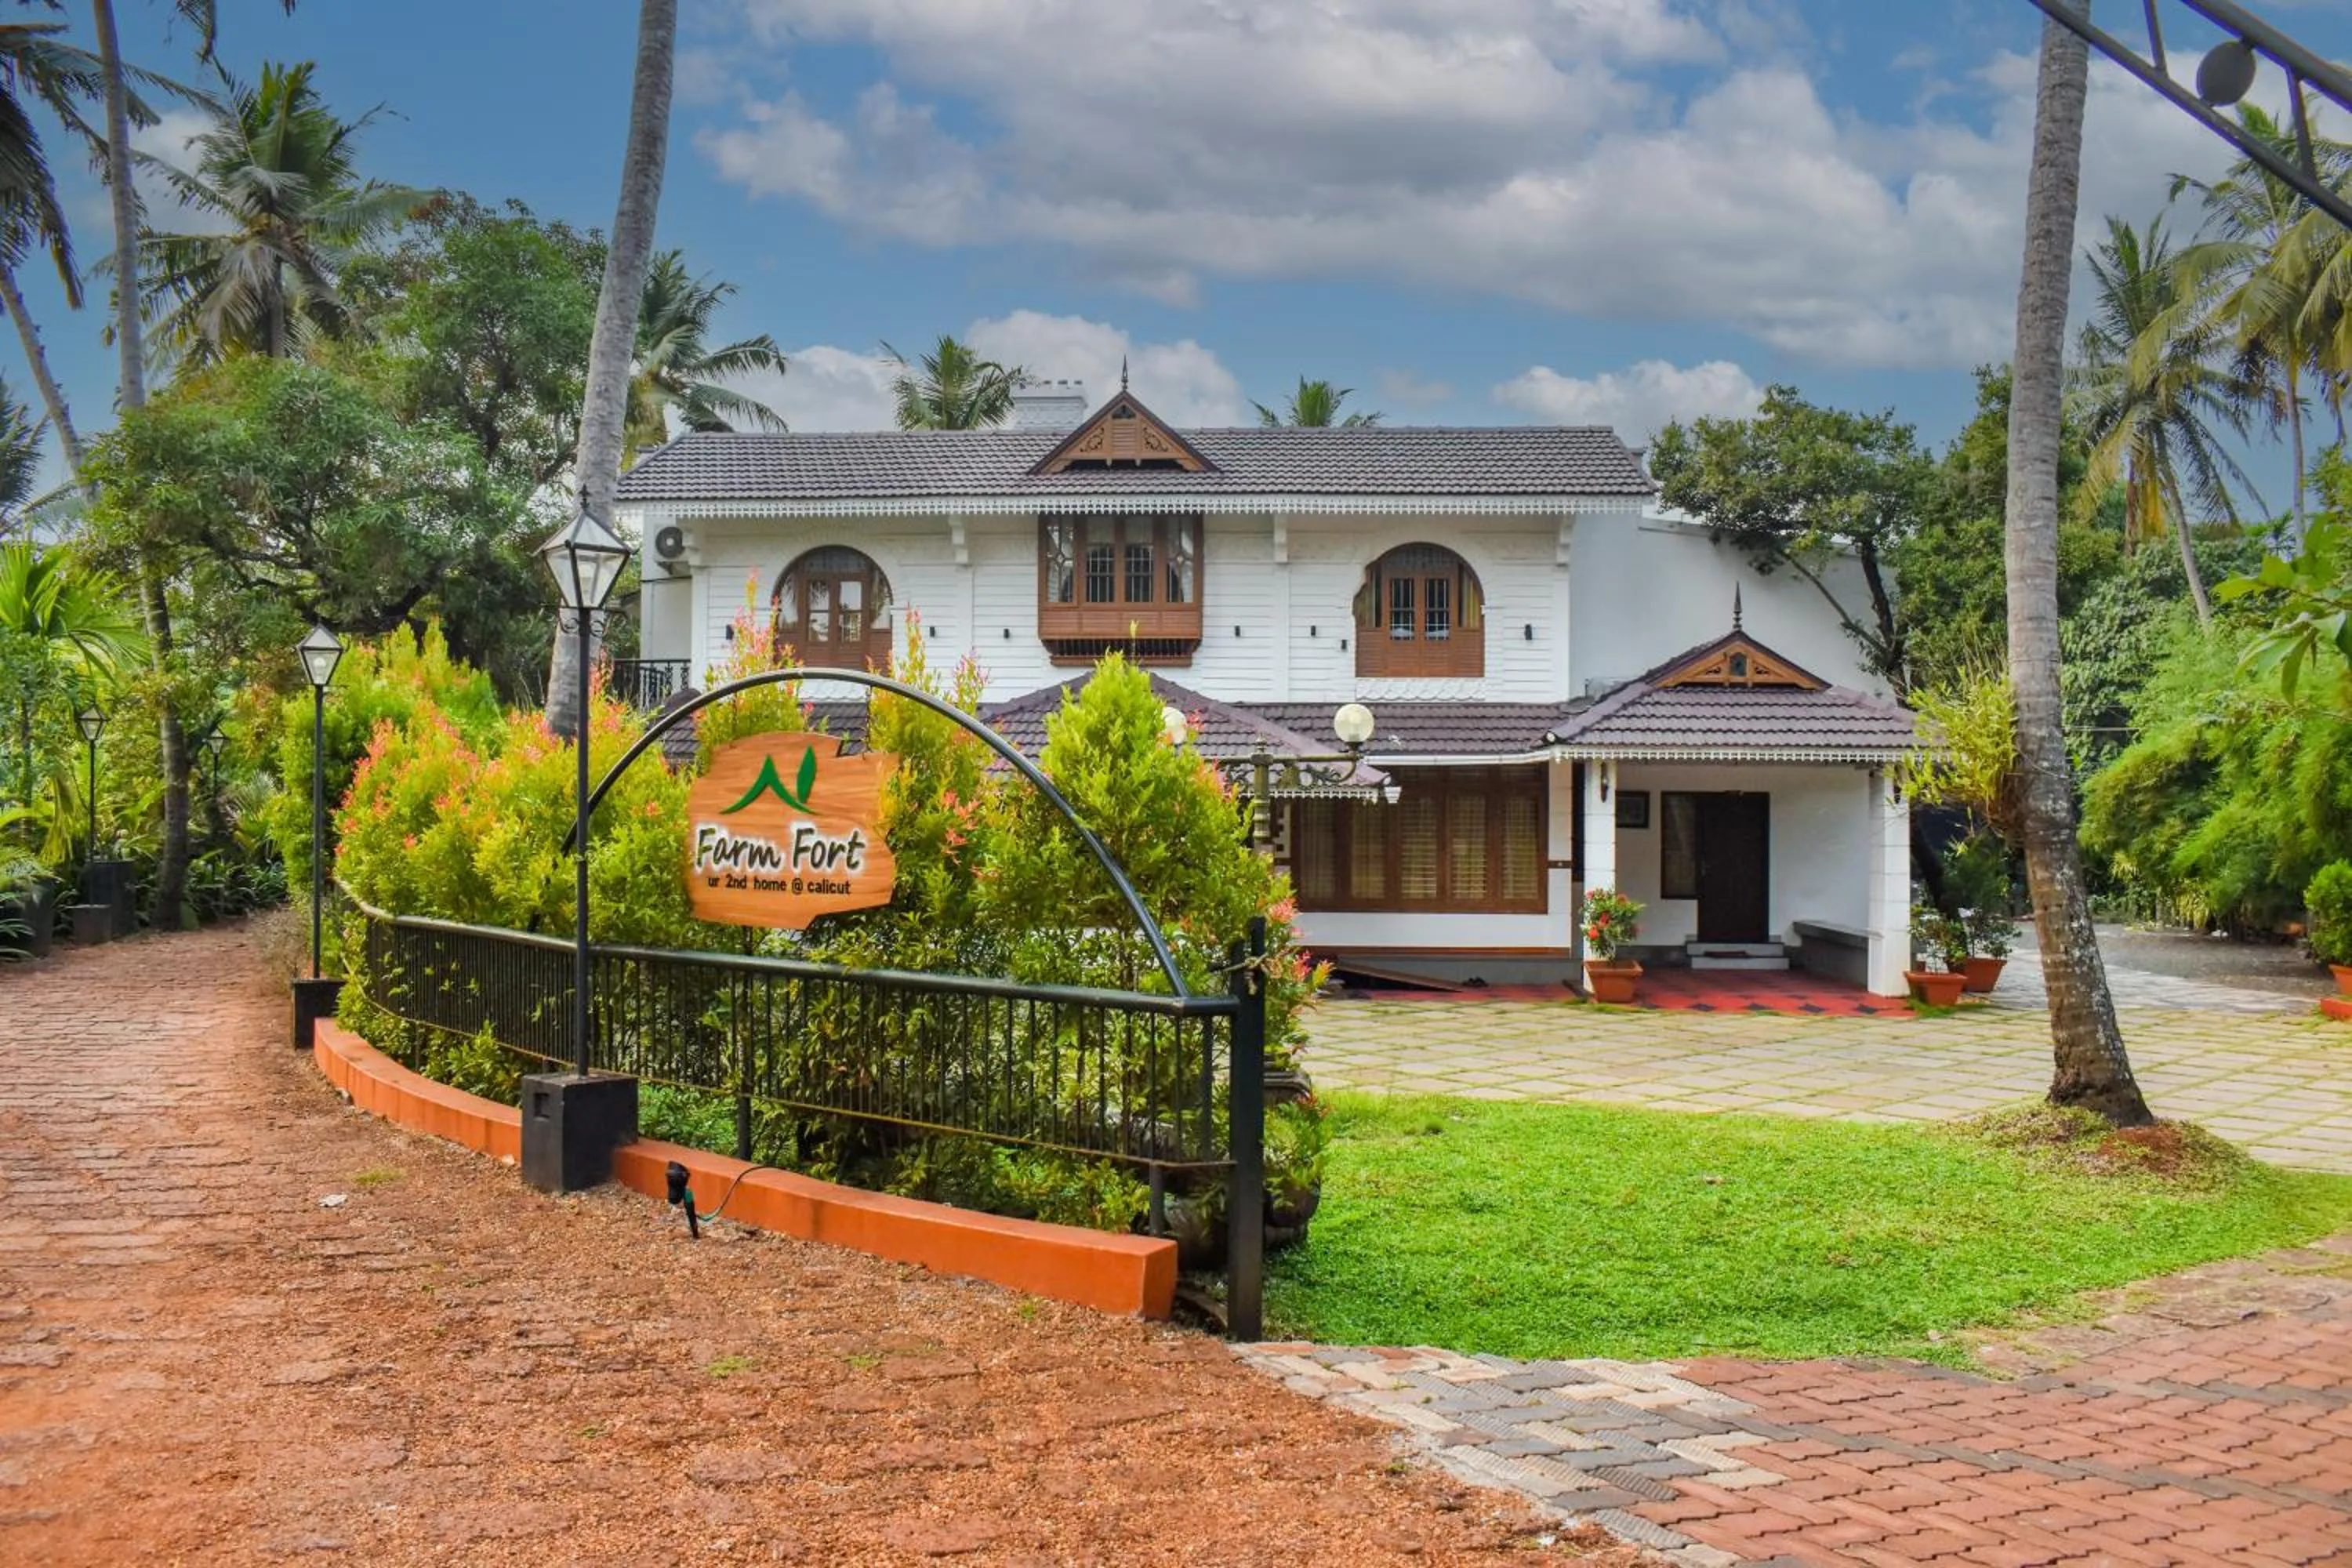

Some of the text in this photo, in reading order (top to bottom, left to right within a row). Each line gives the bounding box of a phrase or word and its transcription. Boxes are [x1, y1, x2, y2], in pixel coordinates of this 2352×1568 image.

[695, 826, 866, 869] Farm Fort
[708, 874, 851, 895] ur 2nd home @ calicut
